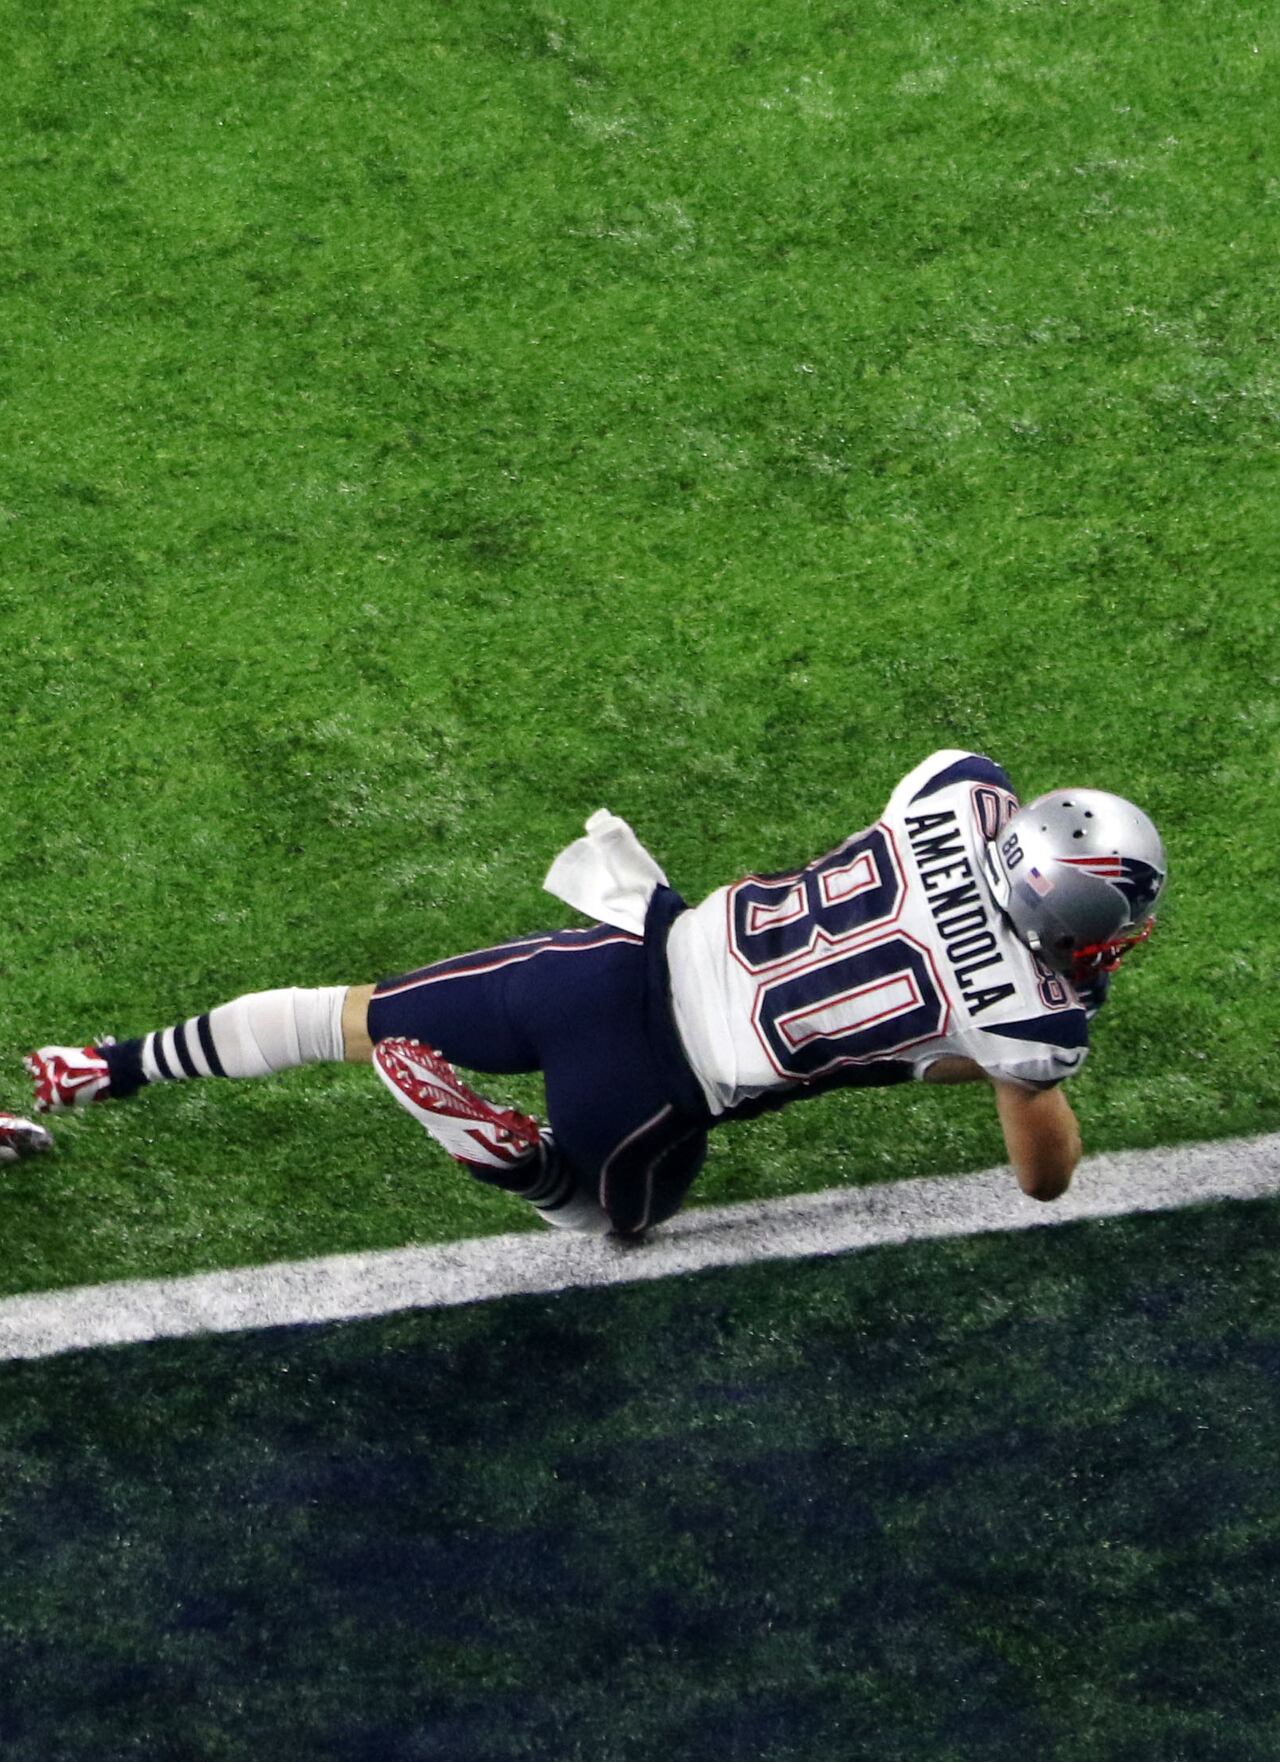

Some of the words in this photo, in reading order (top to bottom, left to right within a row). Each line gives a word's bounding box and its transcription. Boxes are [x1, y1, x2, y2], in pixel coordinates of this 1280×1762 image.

[727, 822, 951, 1082] 80
[905, 809, 1016, 1018] AMENDOLA
[1001, 832, 1025, 870] 80
